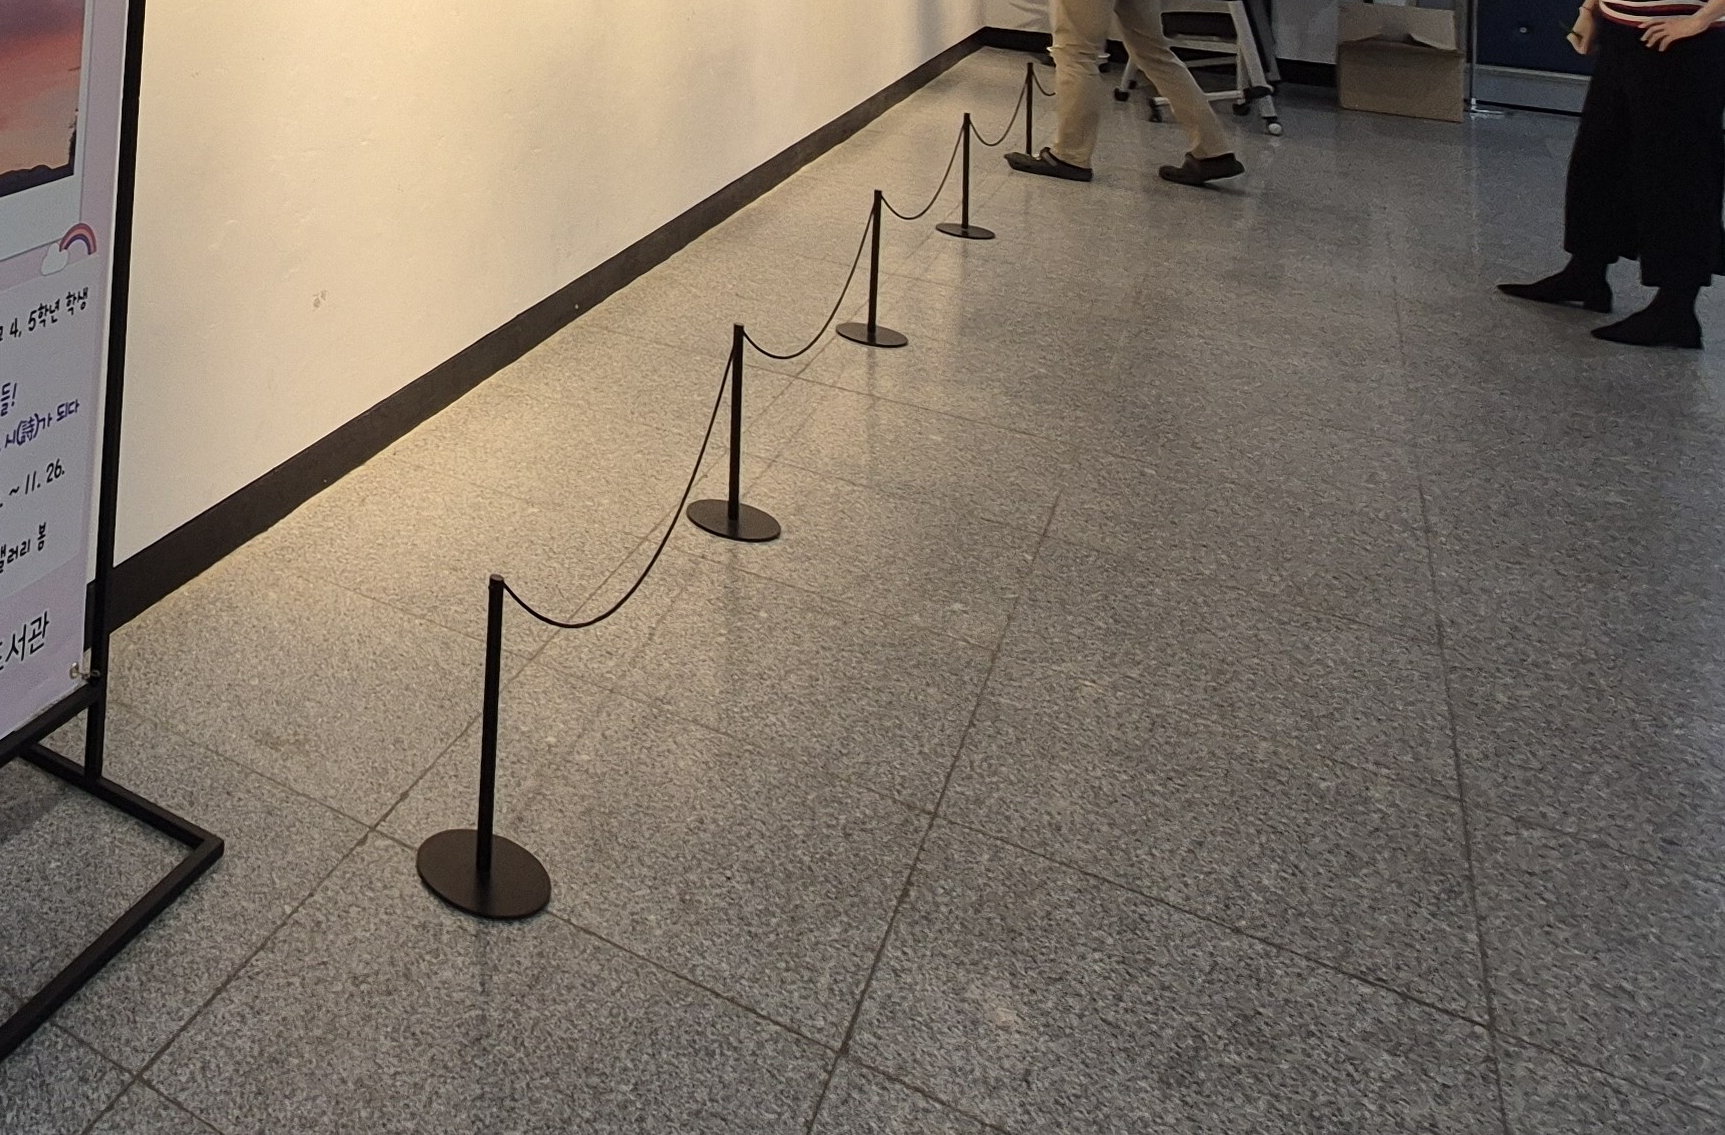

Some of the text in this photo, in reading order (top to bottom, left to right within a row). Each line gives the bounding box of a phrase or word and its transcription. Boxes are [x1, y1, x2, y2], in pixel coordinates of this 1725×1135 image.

[27, 298, 62, 332] 5학년
[65, 287, 89, 317] 학생
[56, 399, 81, 422] 되다
[45, 458, 66, 484] 26.
[36, 522, 48, 553] 봄
